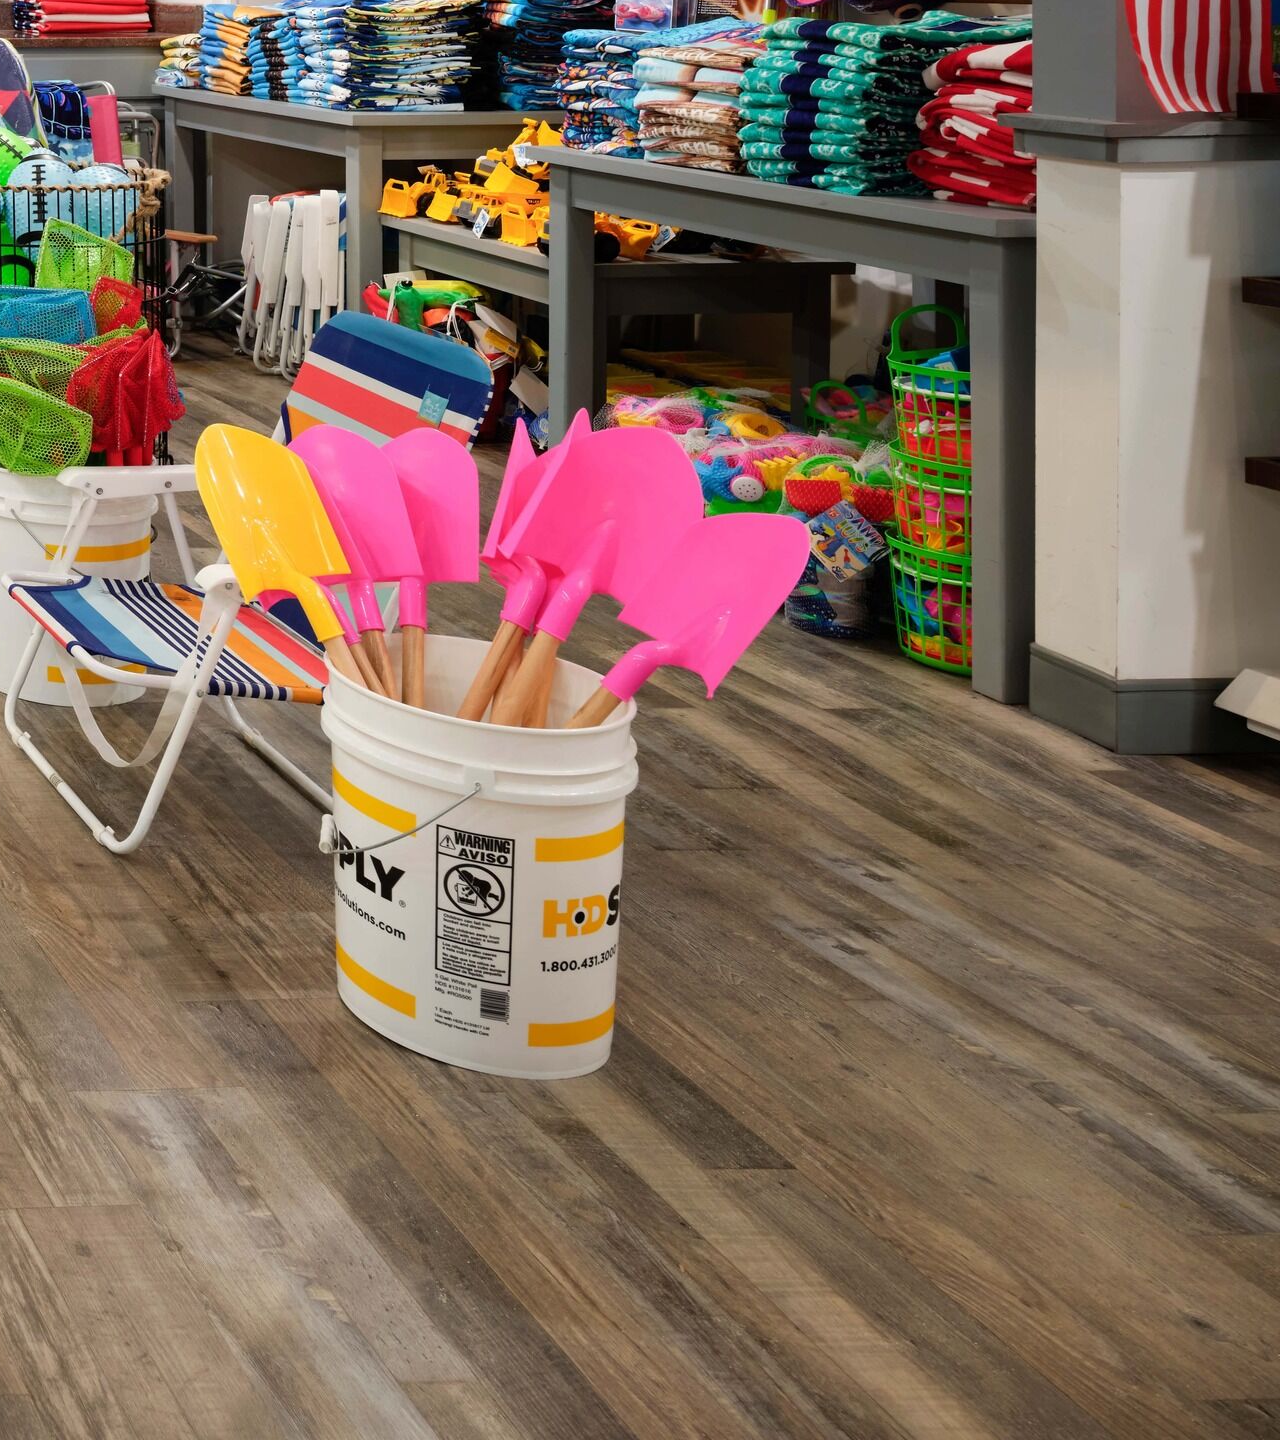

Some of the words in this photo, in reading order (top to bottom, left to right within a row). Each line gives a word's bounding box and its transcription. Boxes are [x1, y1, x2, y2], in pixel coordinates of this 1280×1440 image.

[454, 831, 511, 854] WARNING
[339, 830, 406, 902] PLY
[458, 848, 509, 865] AVISO
